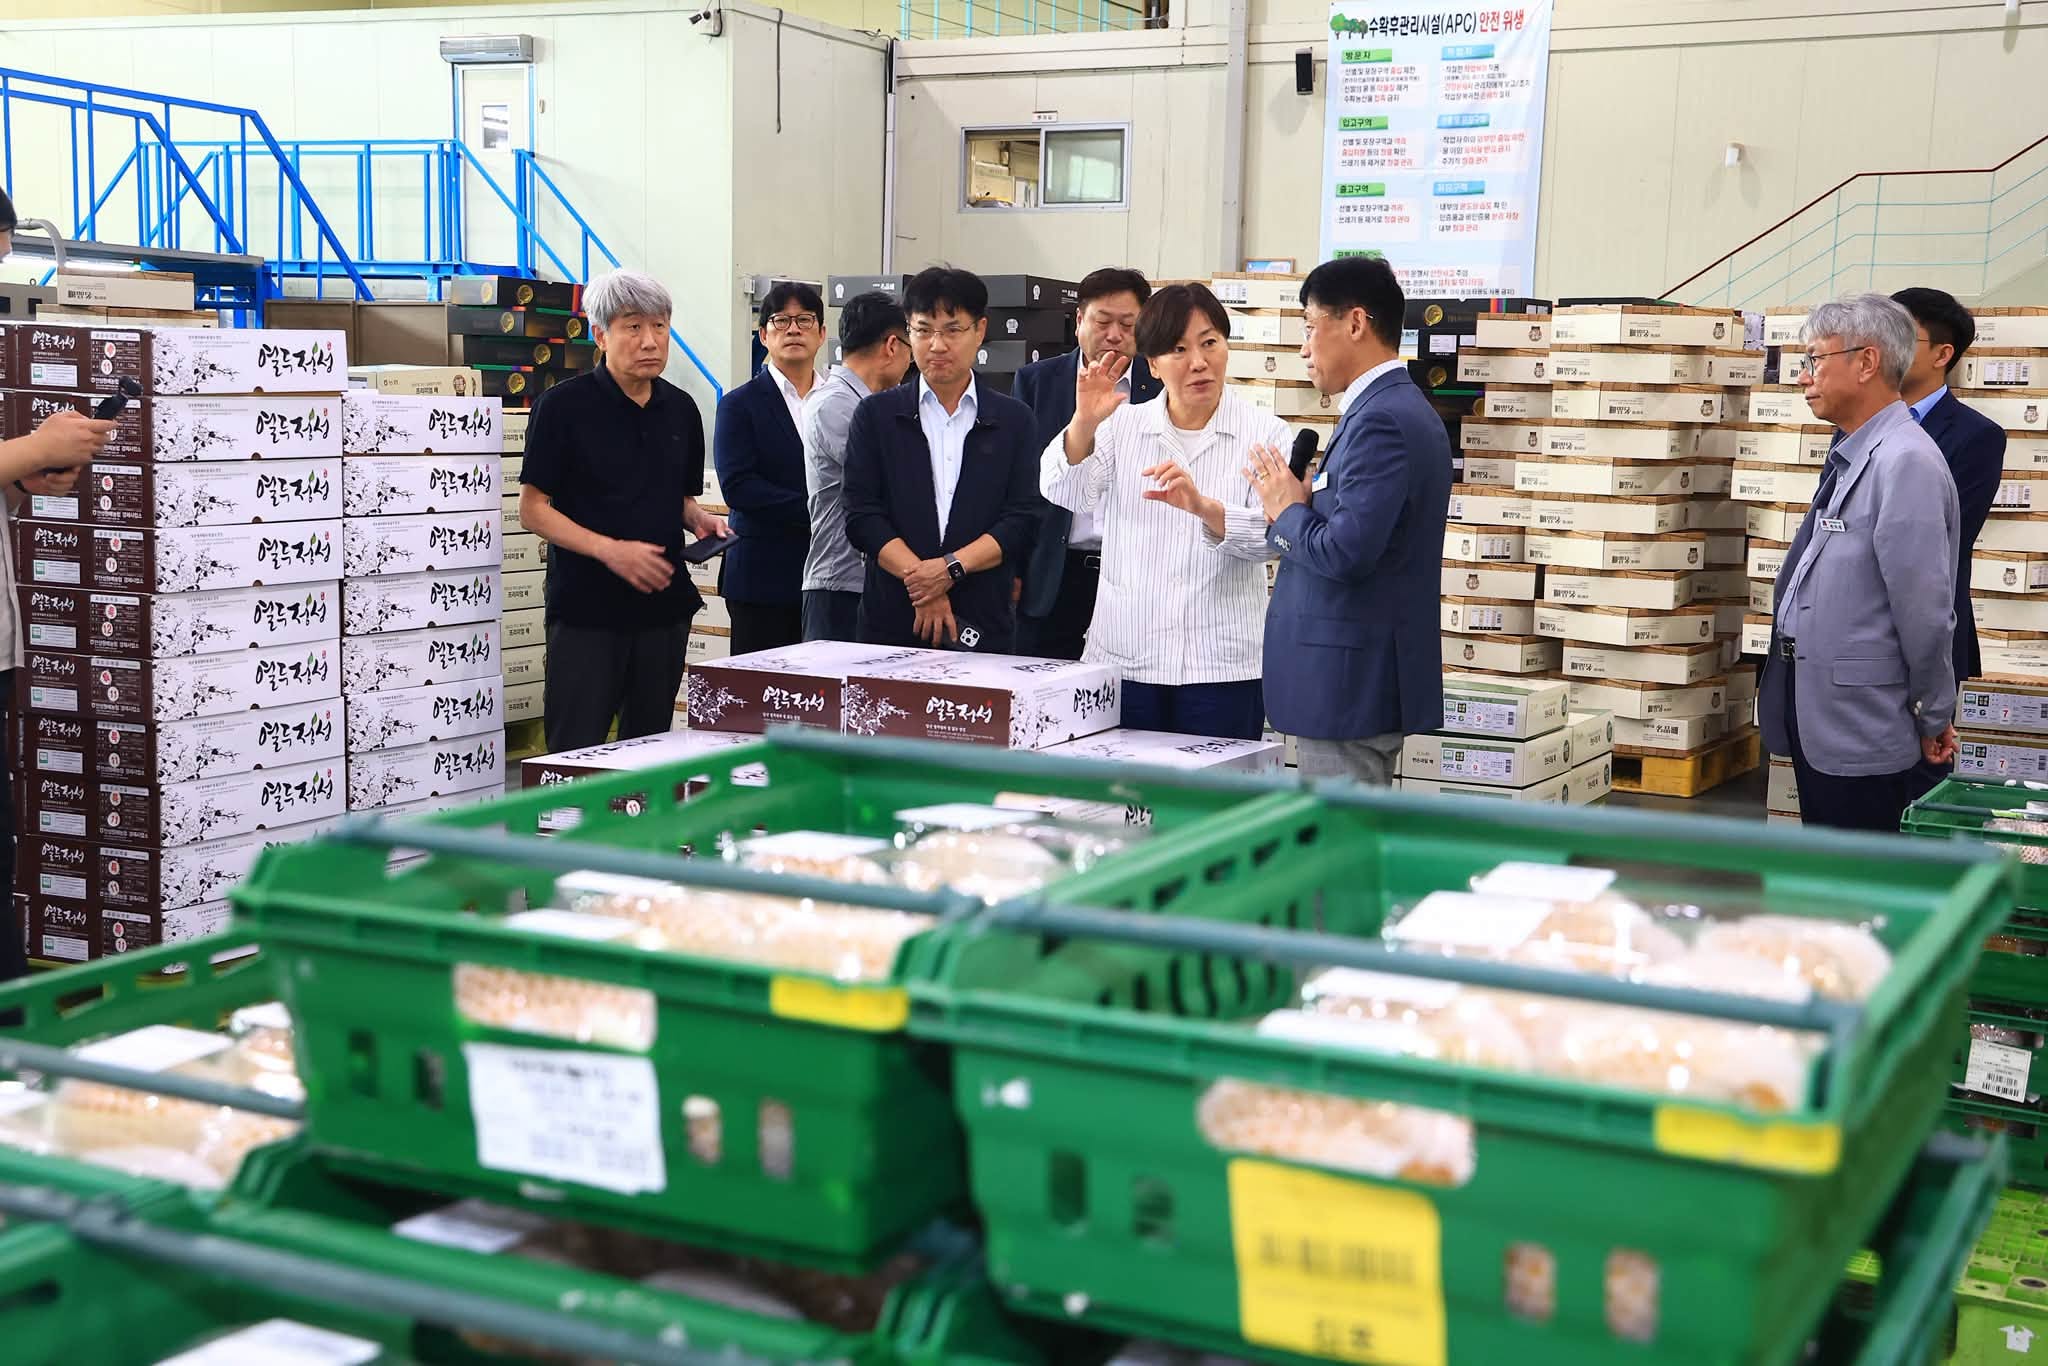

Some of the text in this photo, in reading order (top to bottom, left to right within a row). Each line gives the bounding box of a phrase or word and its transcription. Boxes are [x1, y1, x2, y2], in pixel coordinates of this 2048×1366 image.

[1368, 9, 1524, 37] 수확후관리시설(APC) 안전 위생
[1343, 119, 1372, 127] 입고구역
[1340, 185, 1368, 193] 출고구역
[259, 344, 333, 377] 열두정성
[257, 409, 329, 443] 열두정성
[429, 408, 491, 439] 열두정성
[257, 471, 329, 506] 열두정성
[430, 465, 490, 497] 열두정성
[258, 533, 330, 569] 열두정성
[430, 522, 491, 555] 열두정성
[431, 576, 491, 610] 열두정성
[254, 593, 326, 630] 열두정성
[429, 633, 489, 669] 열두정성
[256, 653, 327, 691] 열두정성
[433, 688, 493, 725] 열두정성
[762, 685, 825, 711] 열두정성
[925, 696, 993, 723] 열두정성
[1073, 680, 1116, 721] 열두정성
[2002, 709, 2009, 718] 7
[259, 713, 331, 748] 열두정성
[434, 743, 494, 780] 열두정성
[1999, 760, 2006, 768] 7
[261, 771, 332, 812] 열두정성
[630, 803, 639, 814] 11
